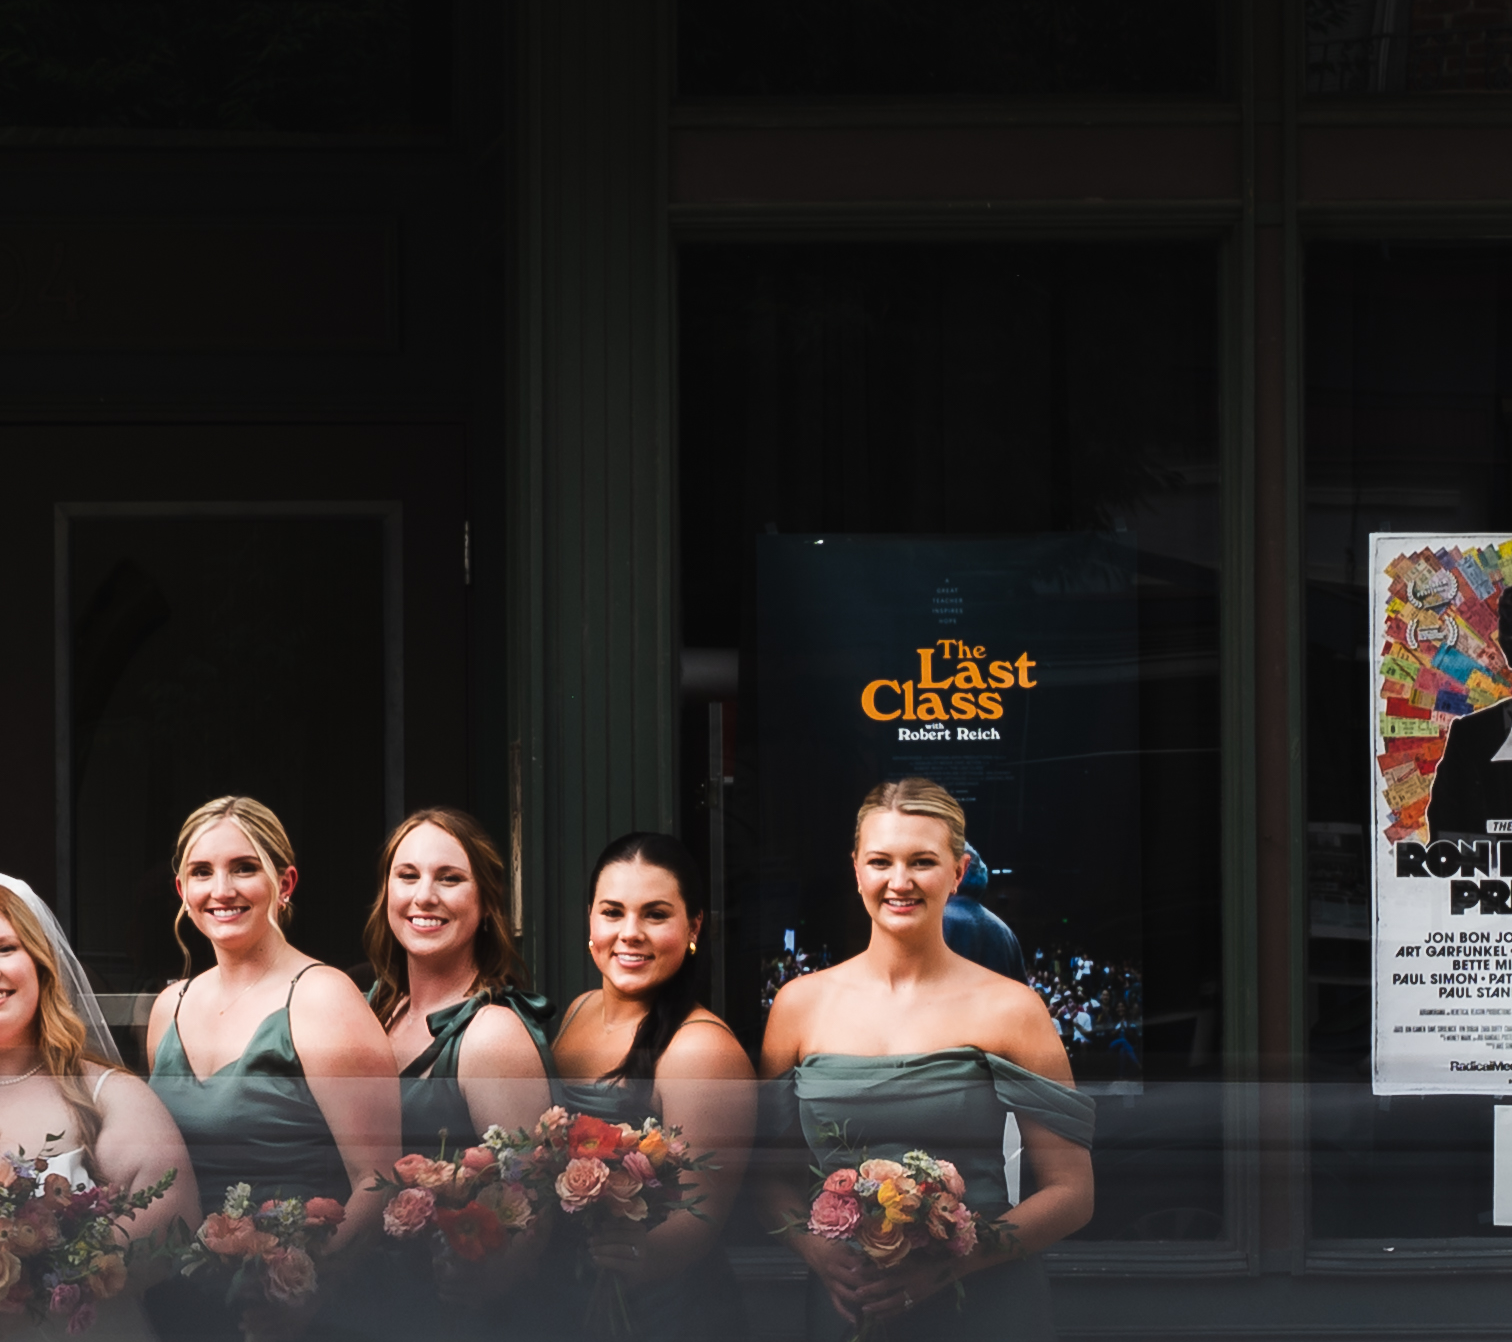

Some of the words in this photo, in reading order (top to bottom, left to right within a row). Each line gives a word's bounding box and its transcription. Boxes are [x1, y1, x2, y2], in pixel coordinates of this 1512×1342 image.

[936, 639, 987, 659] The
[916, 648, 1037, 689] Last
[861, 679, 1004, 722] Class
[898, 728, 951, 740] Robert
[956, 727, 1001, 740] Reich
[1396, 840, 1491, 877] RON
[1424, 931, 1456, 943] JON
[1460, 931, 1491, 943] BON
[1396, 945, 1421, 957] ART
[1426, 945, 1508, 957] GARFUNKEL
[1452, 959, 1491, 970] BETTE
[1393, 972, 1425, 984] PAUL
[1430, 972, 1477, 984] SIMON
[1439, 986, 1472, 998] PAUL
